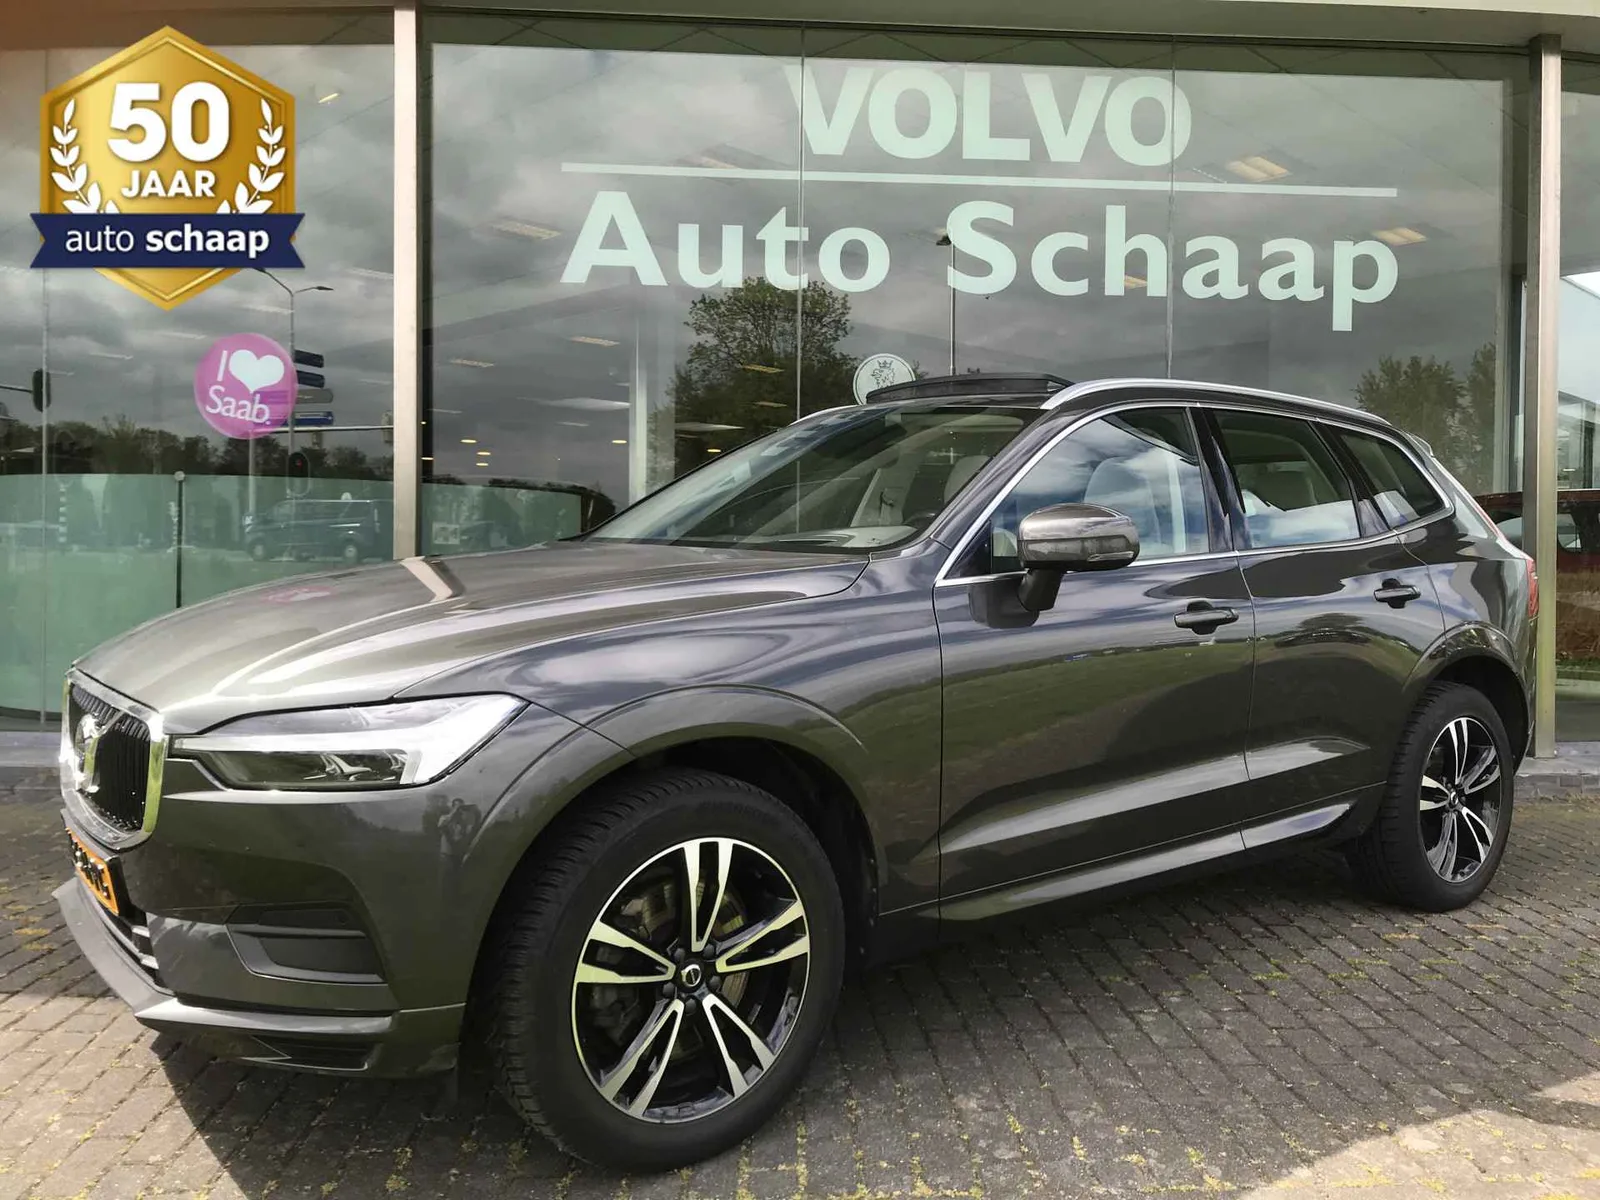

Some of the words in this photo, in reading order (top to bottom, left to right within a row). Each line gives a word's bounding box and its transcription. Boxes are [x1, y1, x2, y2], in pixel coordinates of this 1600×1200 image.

[783, 64, 1192, 167] VOLVO
[560, 190, 891, 293] Auto
[946, 200, 1398, 332] Schaap
[217, 350, 228, 382] I
